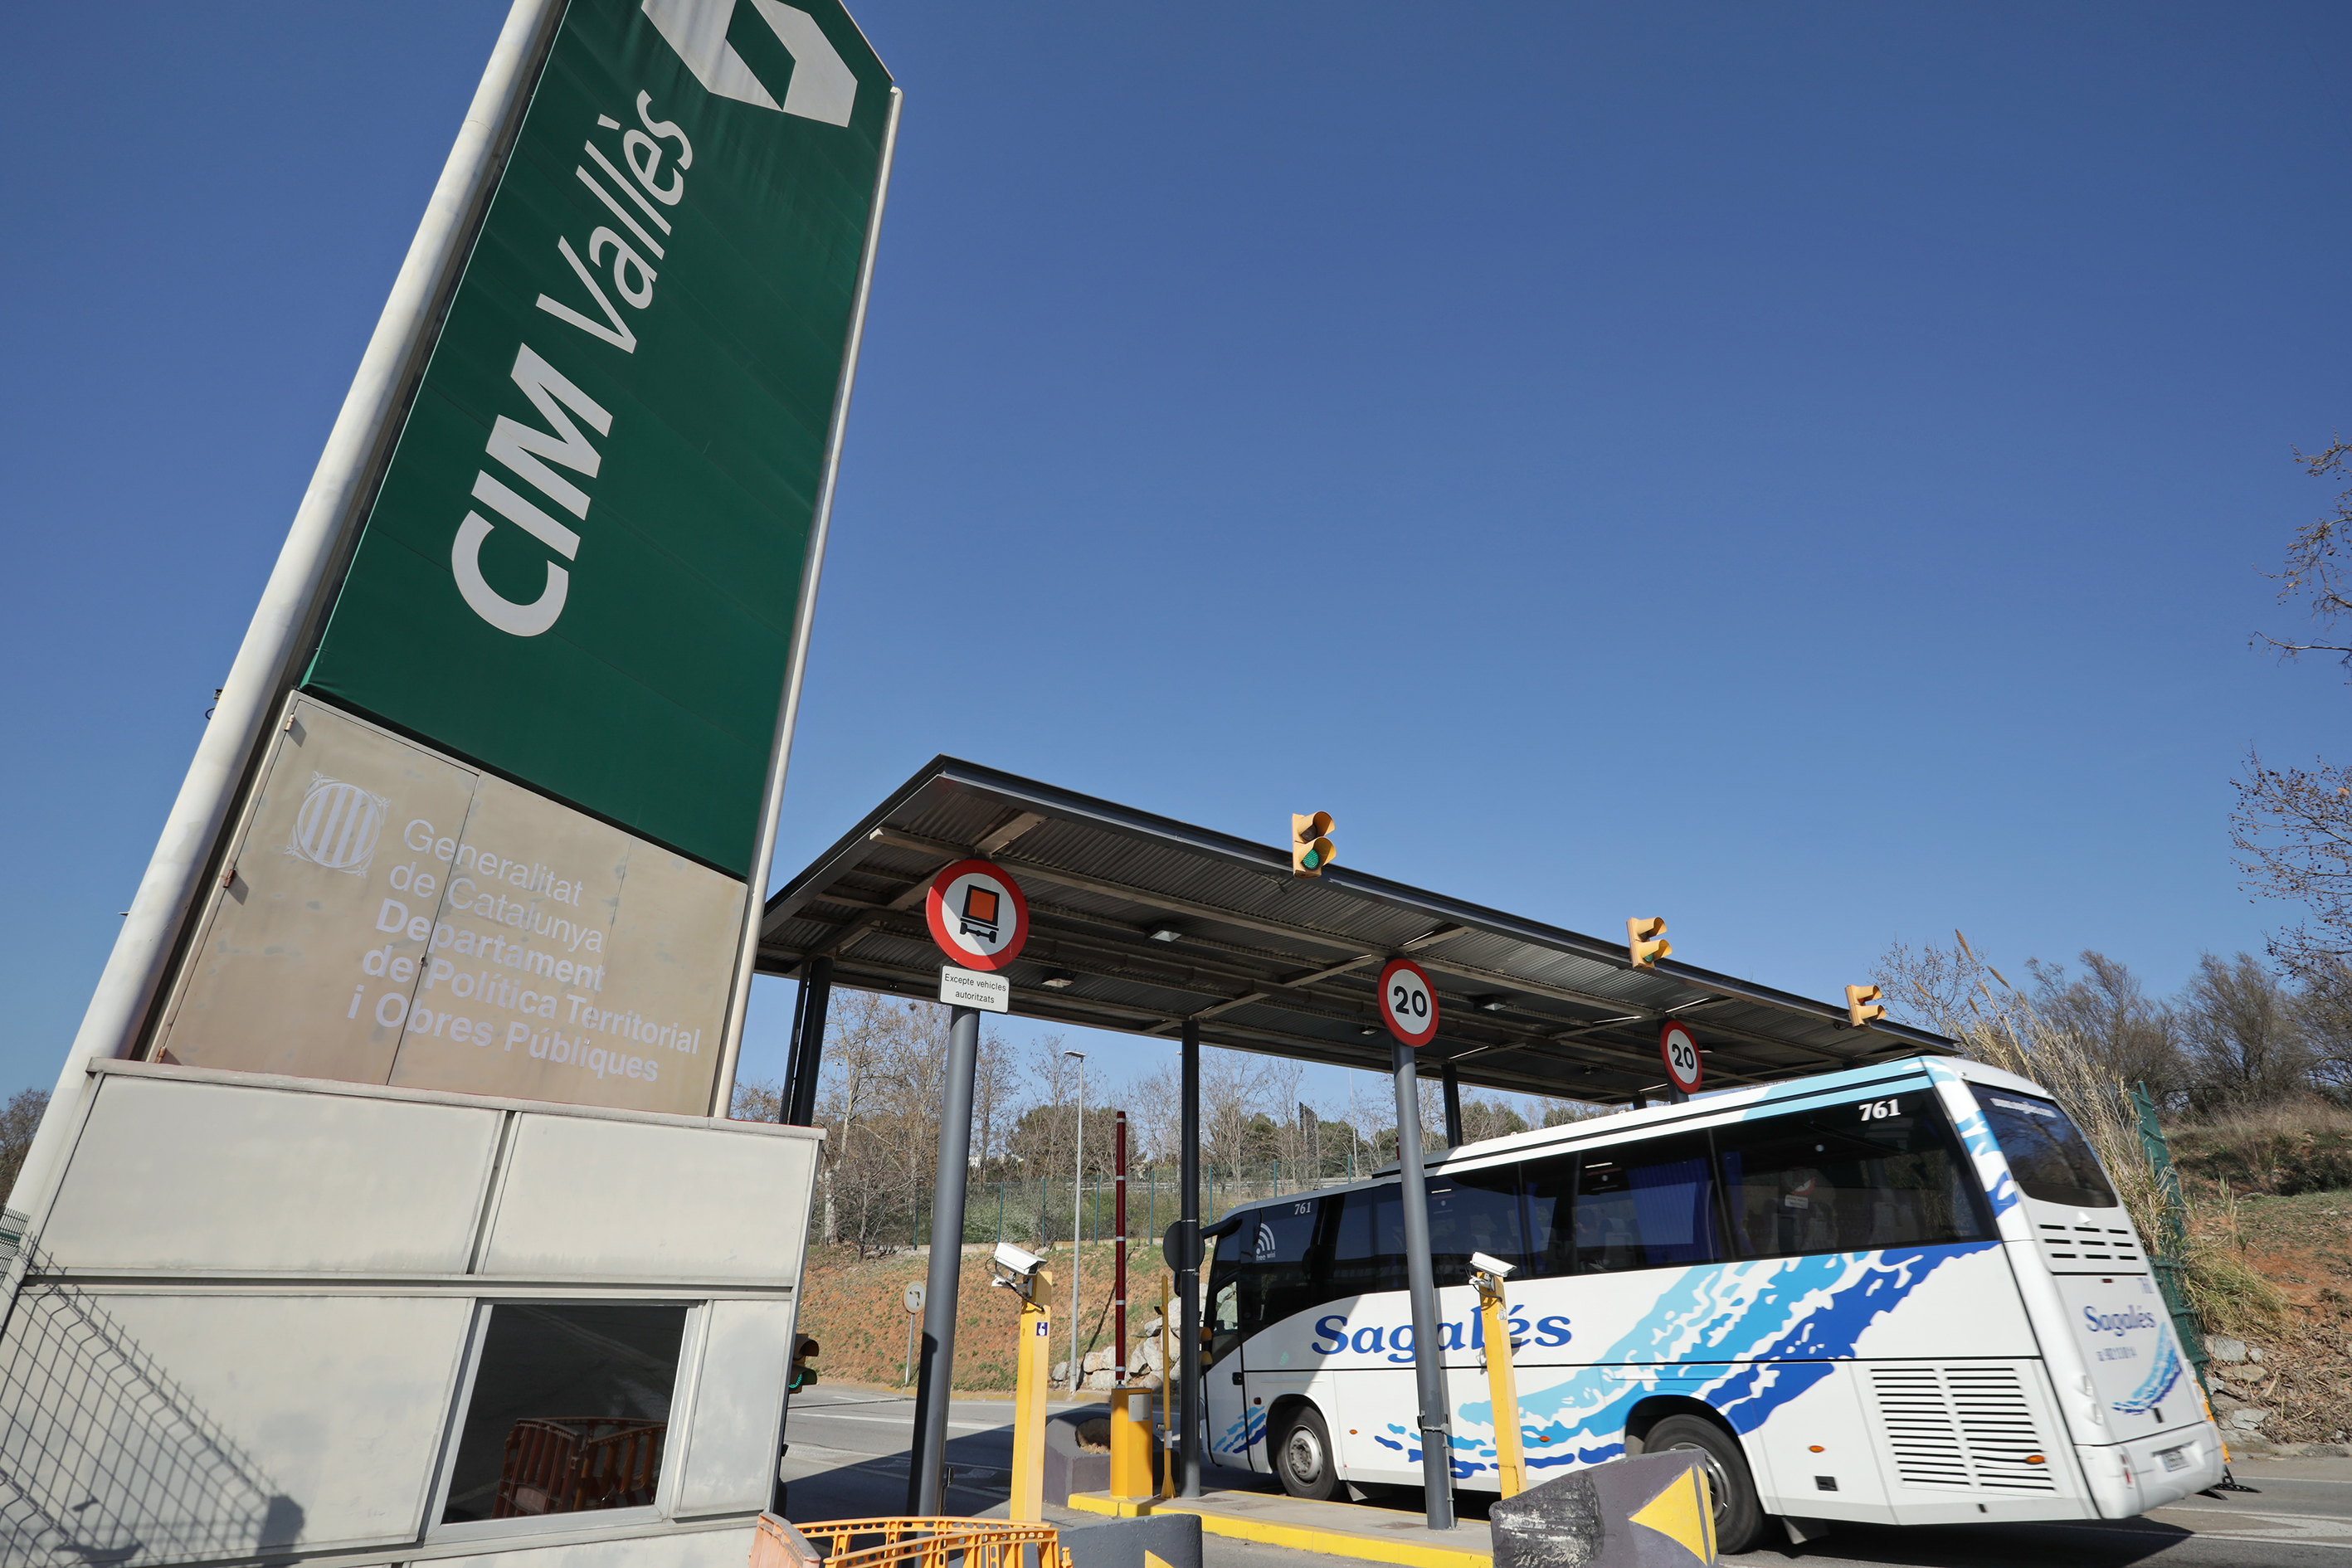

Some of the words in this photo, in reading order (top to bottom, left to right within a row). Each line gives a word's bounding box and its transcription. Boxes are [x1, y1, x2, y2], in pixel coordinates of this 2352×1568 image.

[451, 342, 613, 637] CIM
[535, 89, 693, 353] Vallès
[404, 819, 583, 907] Generalitat
[390, 861, 436, 898] de
[448, 878, 603, 952] Catalunya
[375, 898, 606, 992] Departament
[363, 944, 414, 982] de
[425, 958, 558, 1020] Política
[566, 994, 701, 1054] Territorial
[945, 974, 975, 986] Excepte
[976, 981, 1006, 992] vehicles
[955, 991, 995, 1004] autoritzats
[1393, 985, 1428, 1018] 20
[347, 984, 364, 1020] i
[376, 992, 494, 1047] Obres
[504, 1021, 659, 1082] Públiques
[1671, 1043, 1695, 1070] 20
[1858, 1098, 1901, 1121] 761
[1294, 1202, 1311, 1215] 761
